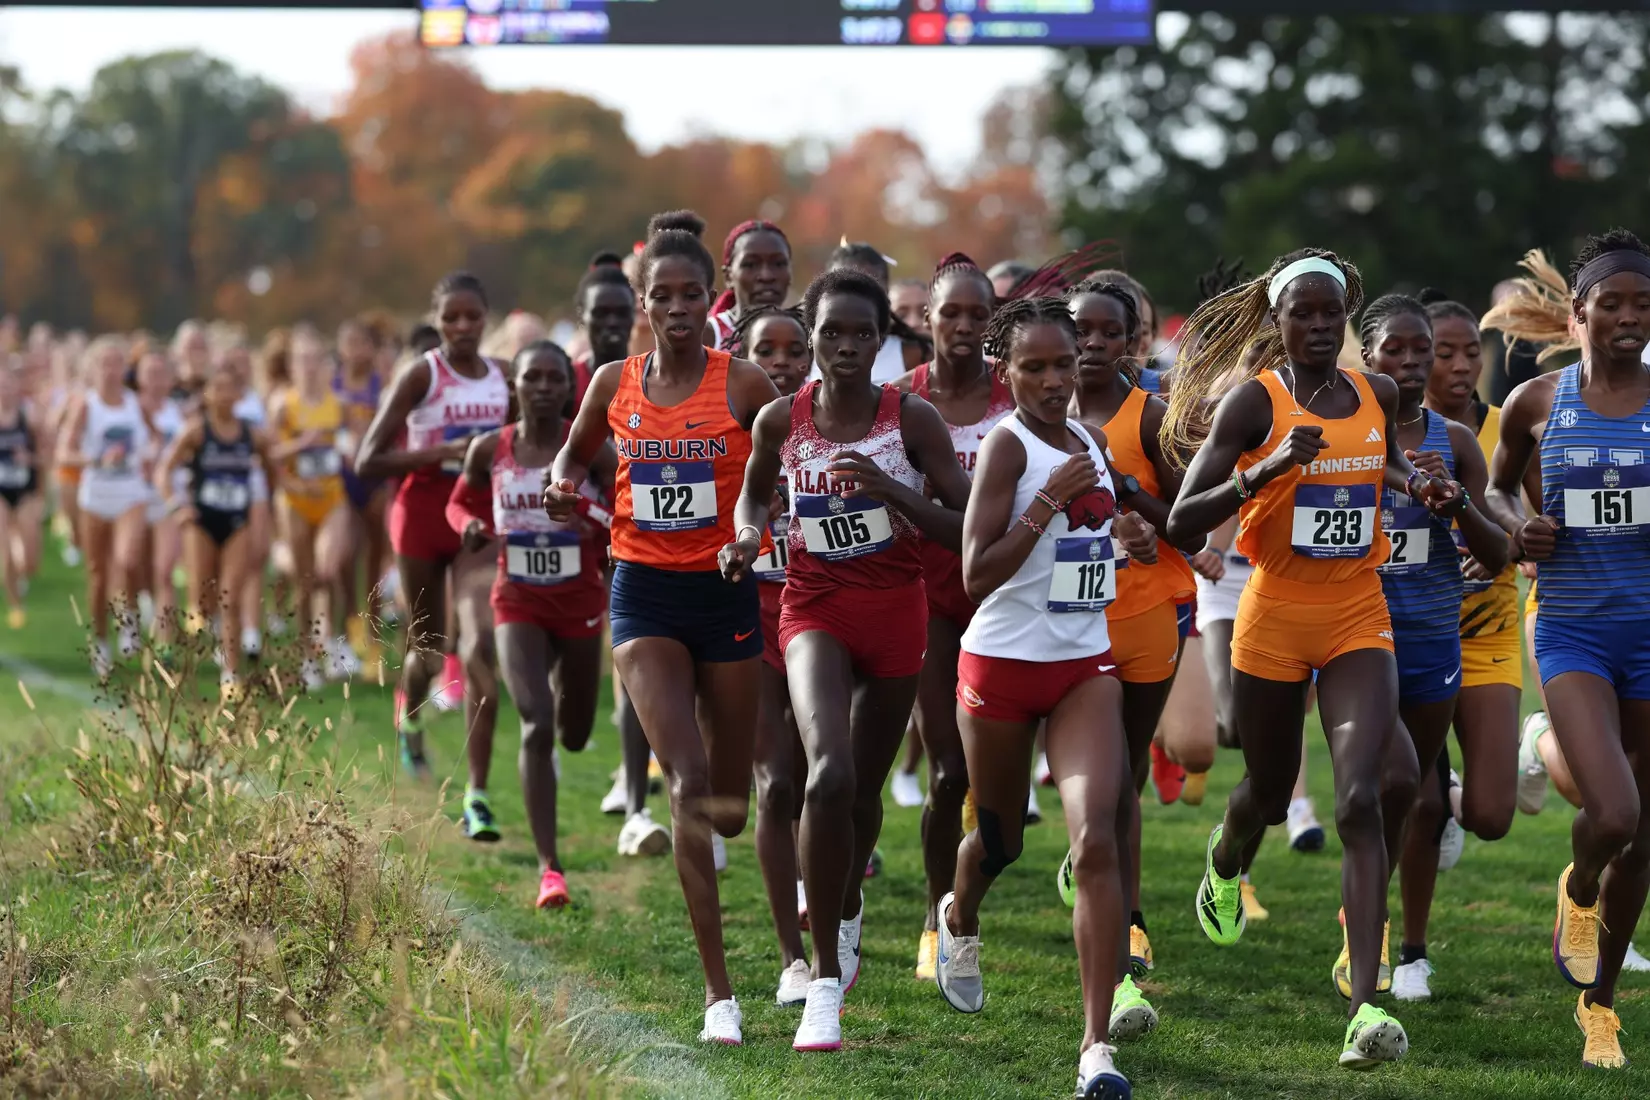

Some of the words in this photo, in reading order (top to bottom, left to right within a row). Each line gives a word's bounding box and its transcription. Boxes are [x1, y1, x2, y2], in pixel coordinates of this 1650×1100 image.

[1560, 409, 1577, 427] SEC
[618, 436, 727, 460] AUBURN
[800, 442, 812, 459] SEC
[649, 485, 695, 520] 122
[1591, 490, 1633, 525] 151
[818, 512, 871, 551] 105
[1312, 509, 1363, 545] 233
[524, 550, 561, 575] 109
[1077, 562, 1106, 600] 112
